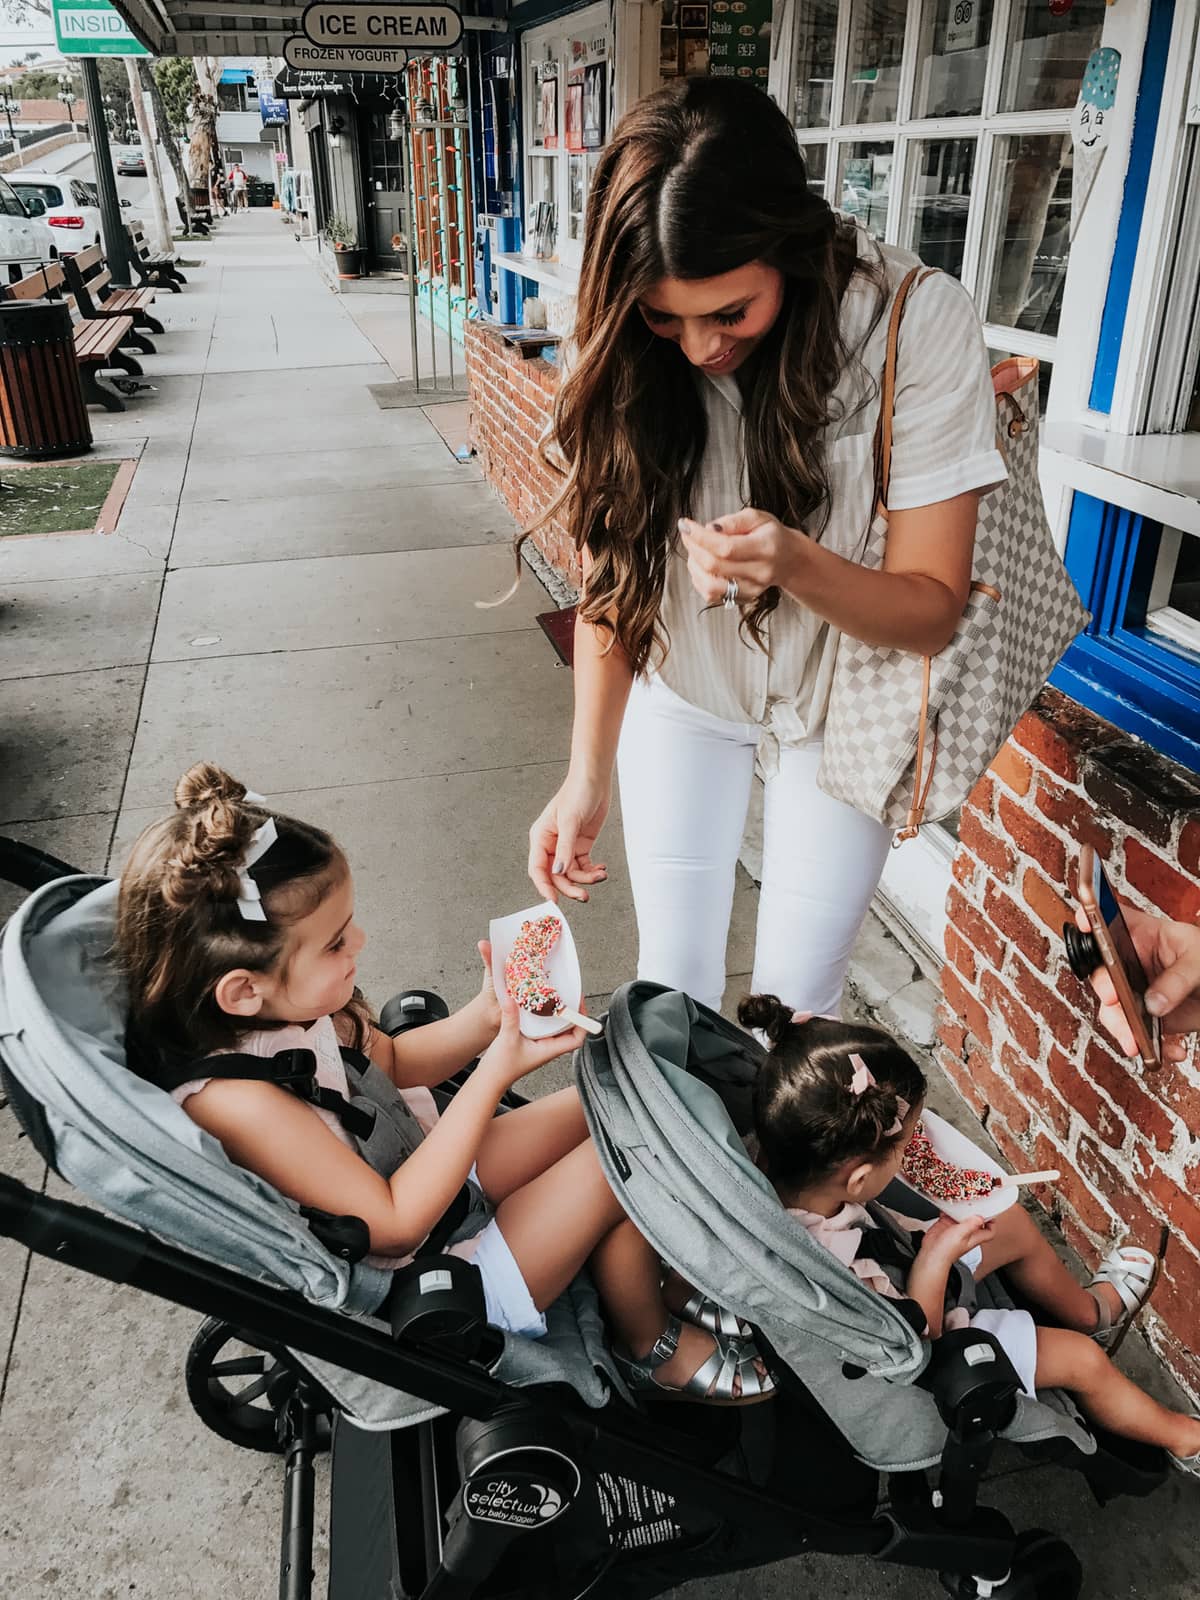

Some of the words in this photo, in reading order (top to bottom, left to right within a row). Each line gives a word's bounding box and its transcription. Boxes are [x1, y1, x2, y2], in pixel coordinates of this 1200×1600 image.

[319, 15, 357, 35] ICE
[367, 16, 448, 36] CREAM
[712, 21, 732, 34] Shake
[294, 48, 344, 61] FROZEN
[348, 49, 399, 62] YOGURT
[712, 42, 728, 56] Float
[711, 63, 735, 76] Sundae
[487, 1480, 518, 1498] city
[476, 1506, 487, 1515] by
[488, 1508, 509, 1520] baby
